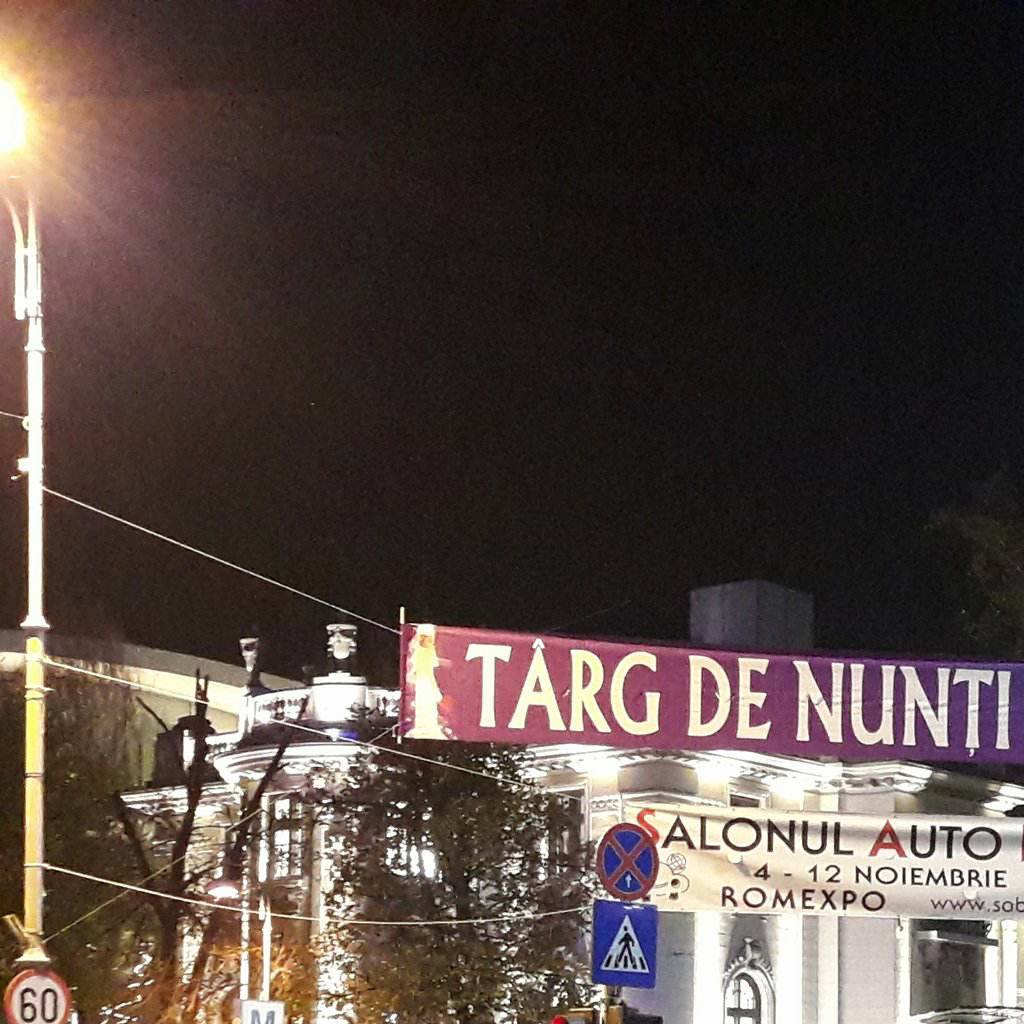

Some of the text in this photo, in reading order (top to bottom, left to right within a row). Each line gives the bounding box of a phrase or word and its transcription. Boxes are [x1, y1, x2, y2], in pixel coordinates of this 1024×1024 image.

[464, 637, 1012, 756] TÂRG DE NUNȚI
[636, 808, 854, 856] SALONUL
[868, 818, 1001, 861] AUTO
[752, 864, 771, 881] 4
[808, 864, 841, 883] 12
[854, 864, 1008, 889] NOIEMBRIE
[720, 886, 886, 912] ROMEXPO
[20, 987, 58, 1024] 60
